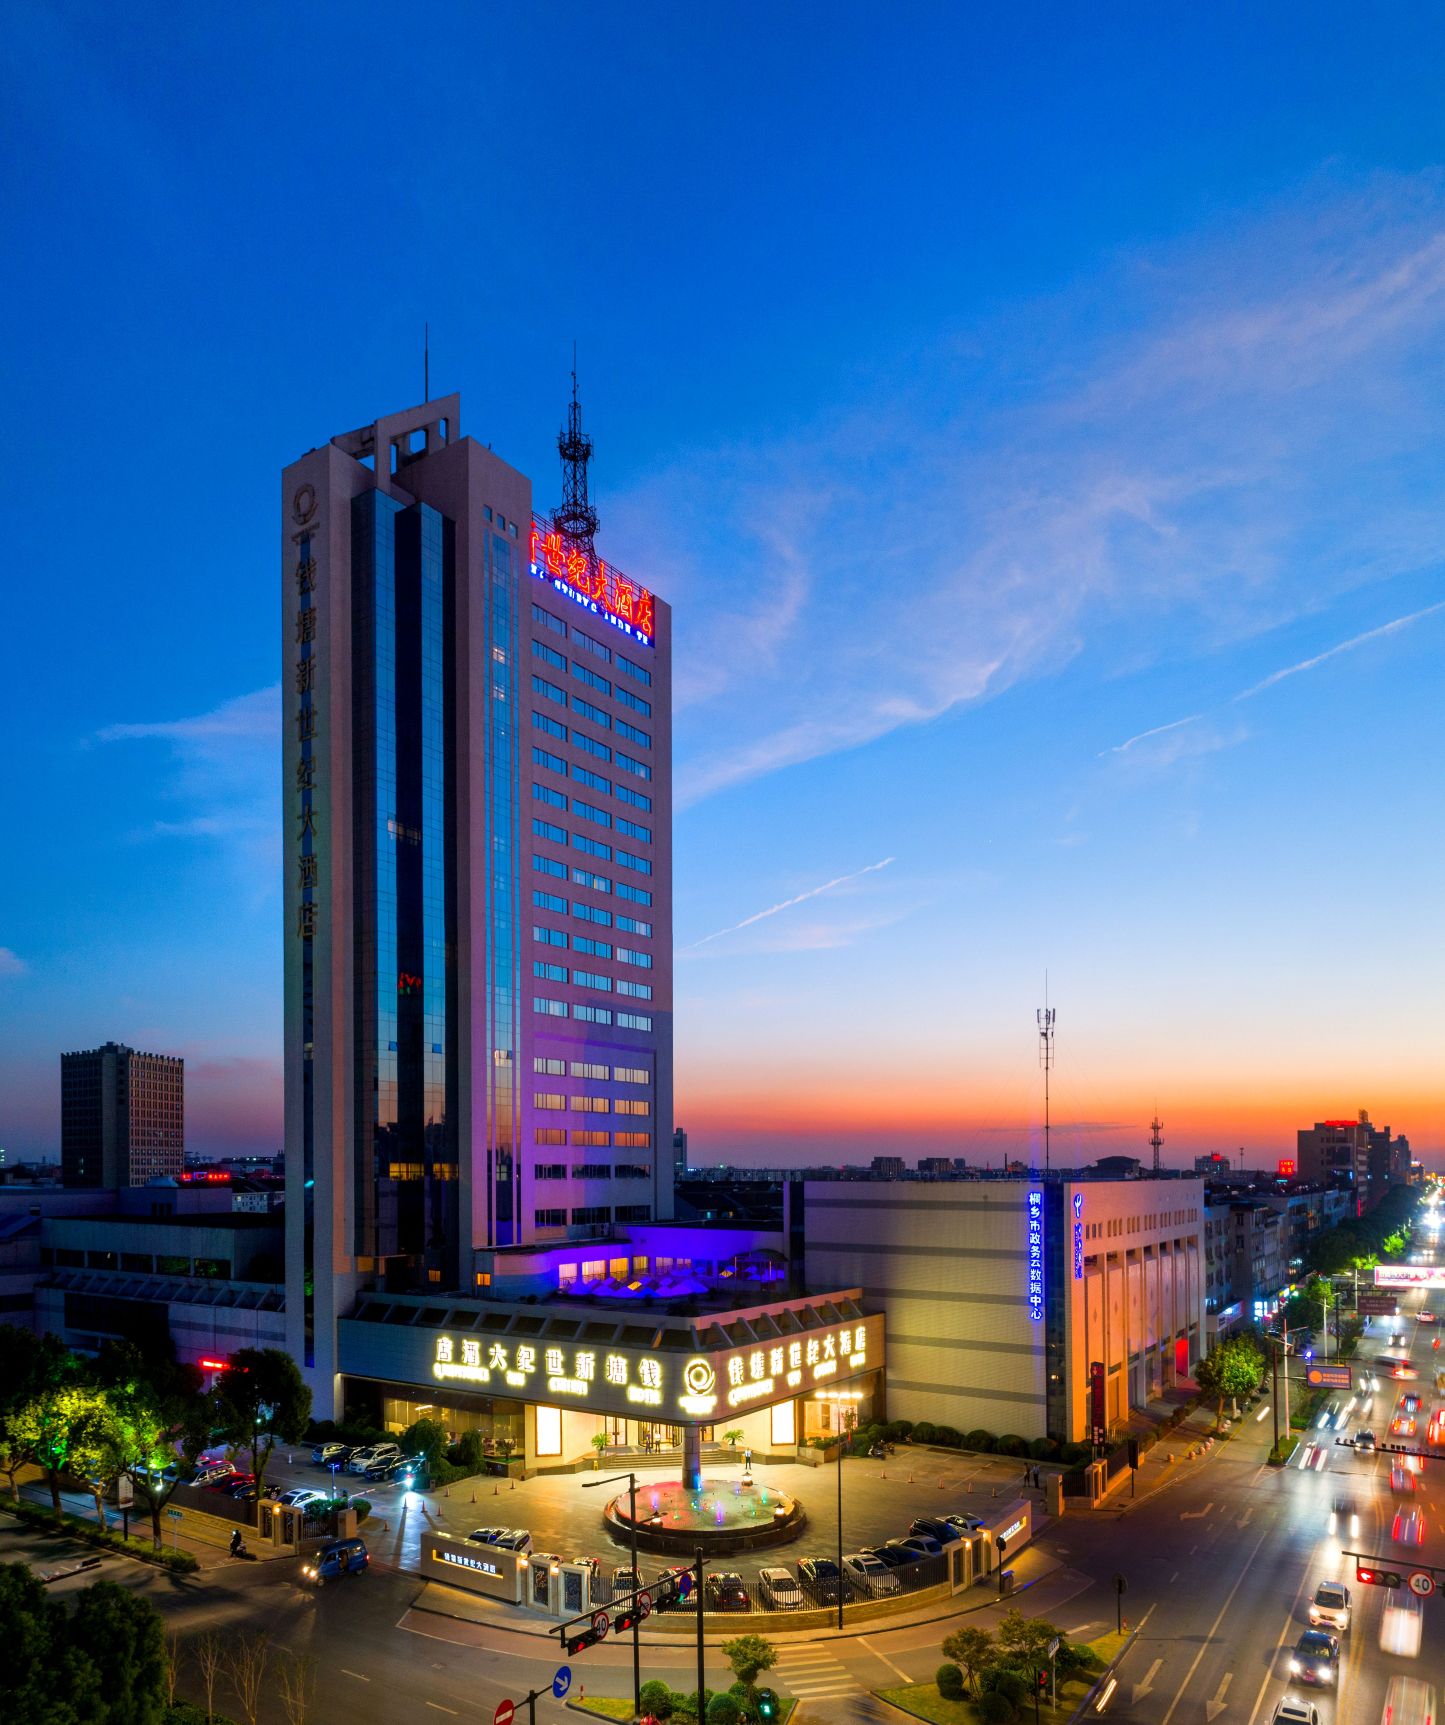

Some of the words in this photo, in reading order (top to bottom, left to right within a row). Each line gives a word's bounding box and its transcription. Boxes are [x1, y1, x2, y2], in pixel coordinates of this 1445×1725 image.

[1029, 1192, 1042, 1320] 桐乡市政务云数据中心
[1415, 1578, 1430, 1592] 40
[596, 1618, 606, 1635] 40
